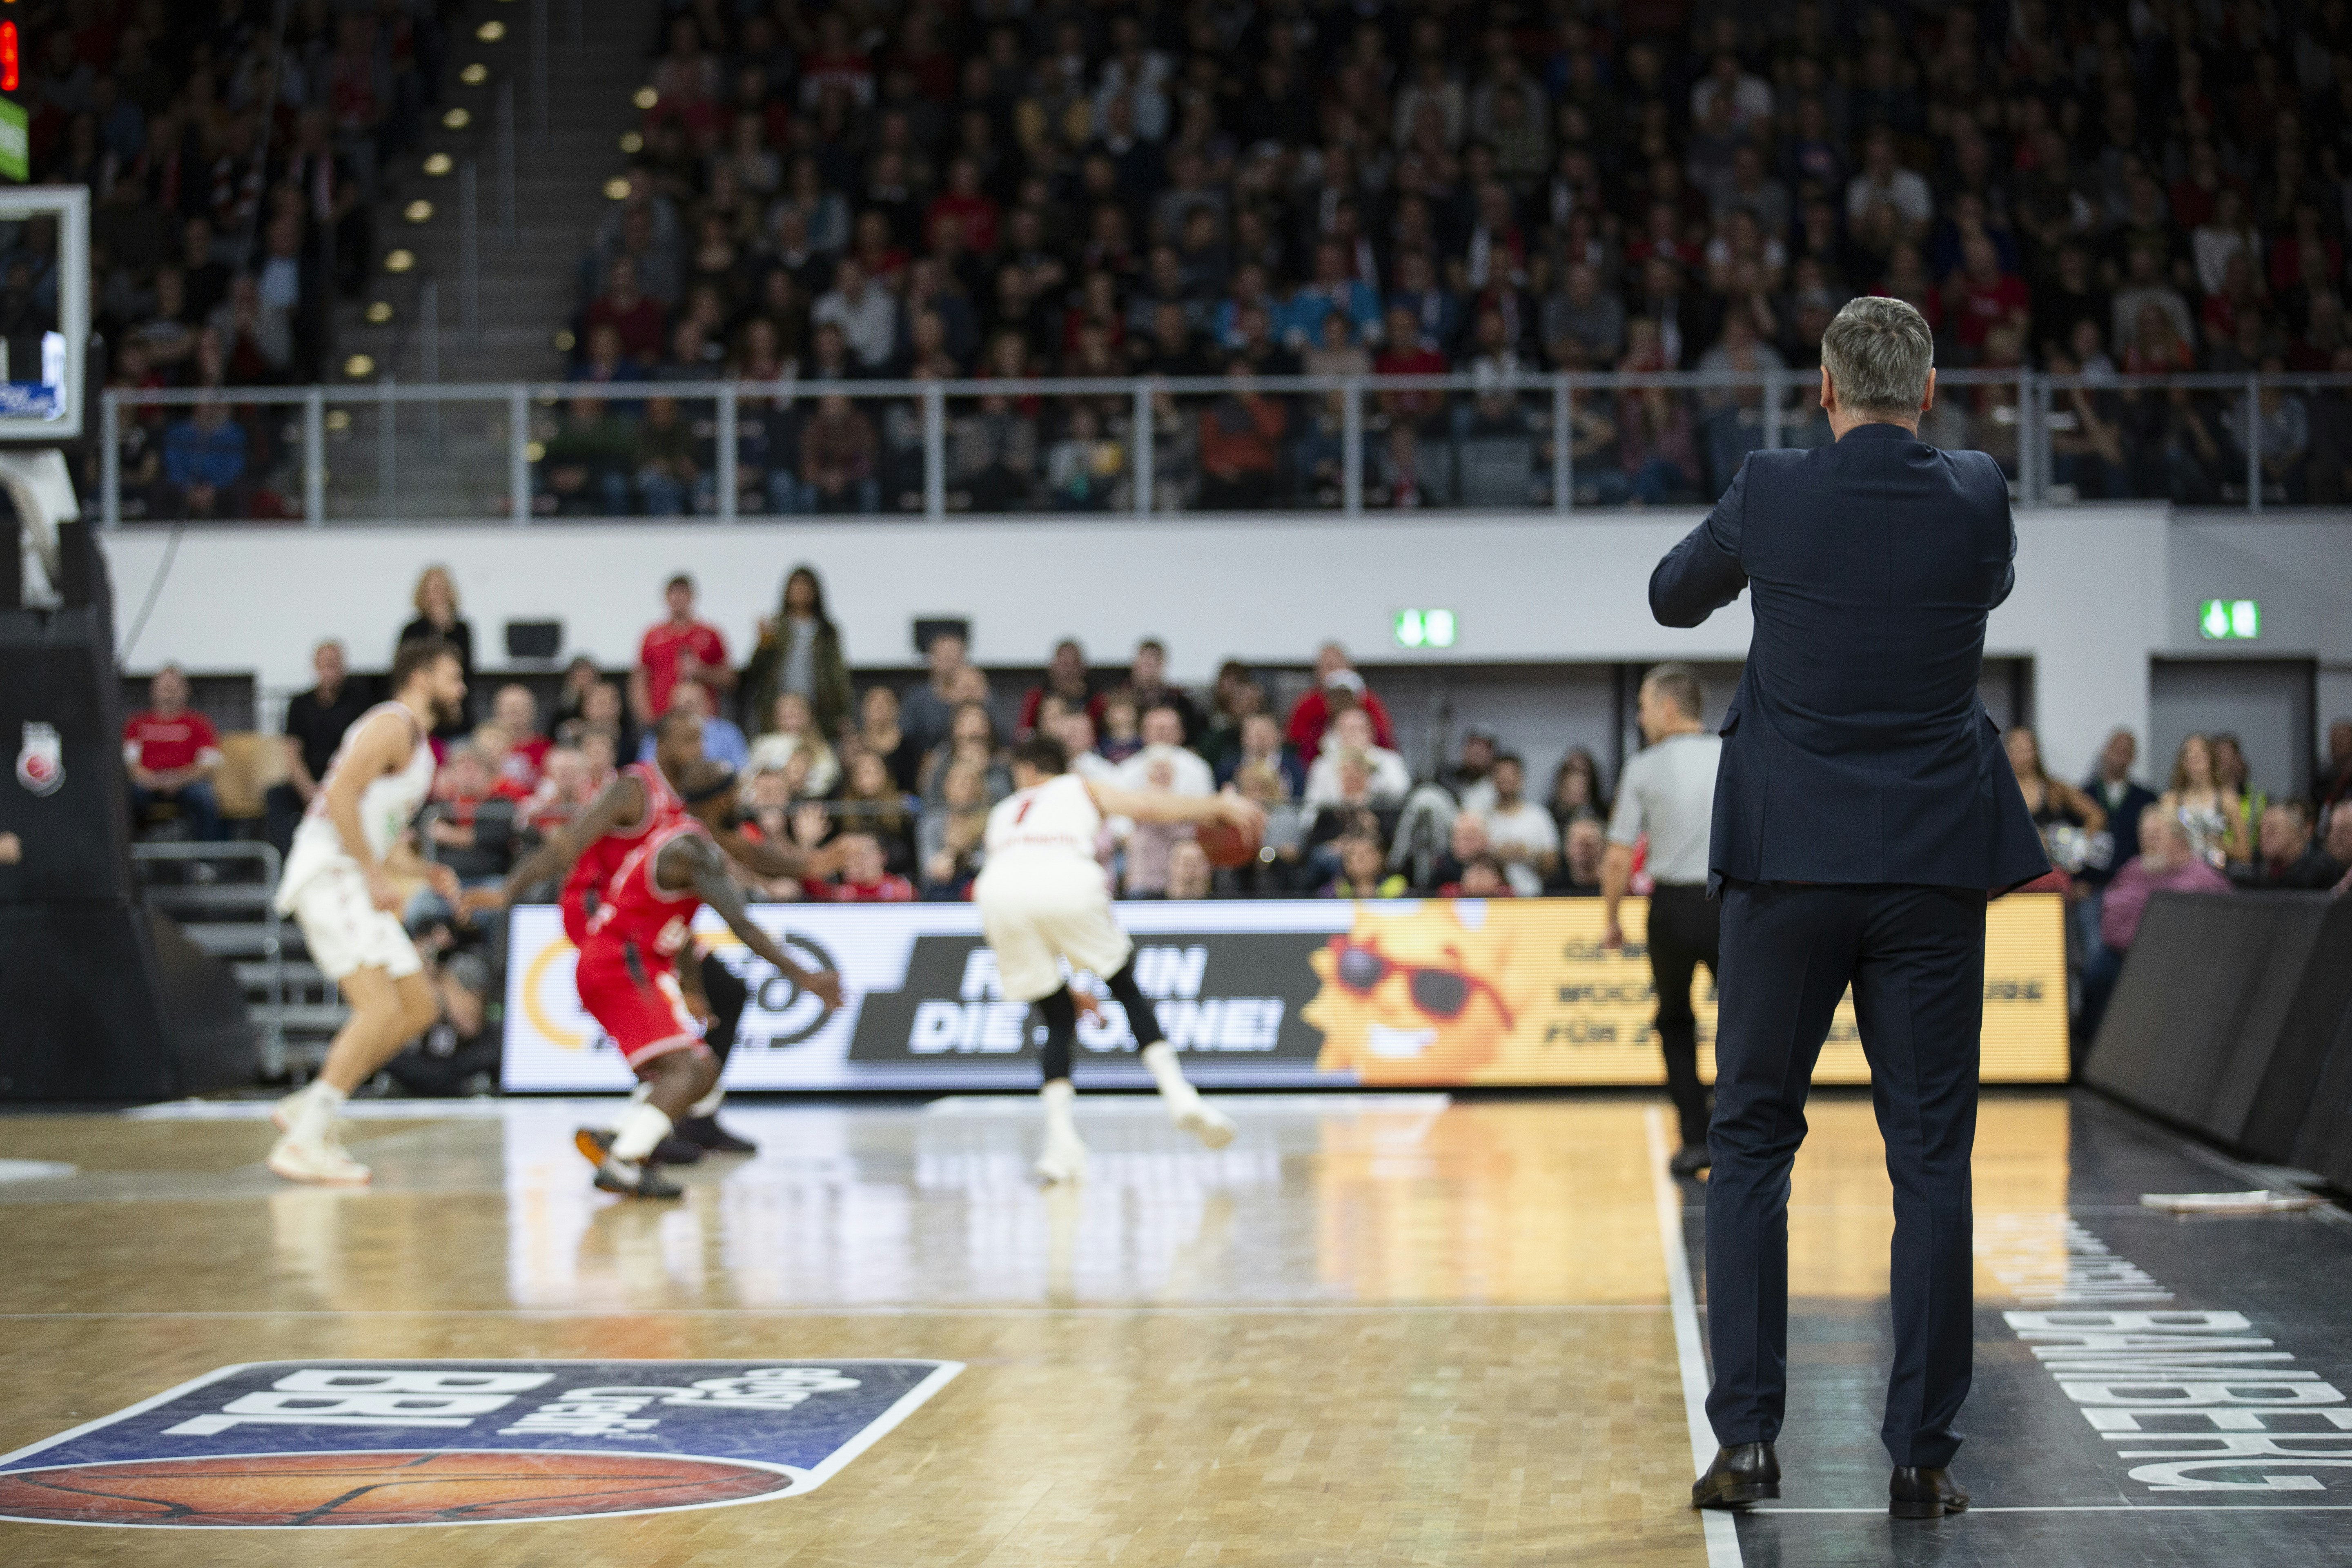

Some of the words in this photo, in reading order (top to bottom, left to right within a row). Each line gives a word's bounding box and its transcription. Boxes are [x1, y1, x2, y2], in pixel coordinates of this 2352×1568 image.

[908, 999, 1030, 1054] DIE
[159, 1368, 557, 1437] BBL
[2002, 1310, 2352, 1491] BAMBERG
